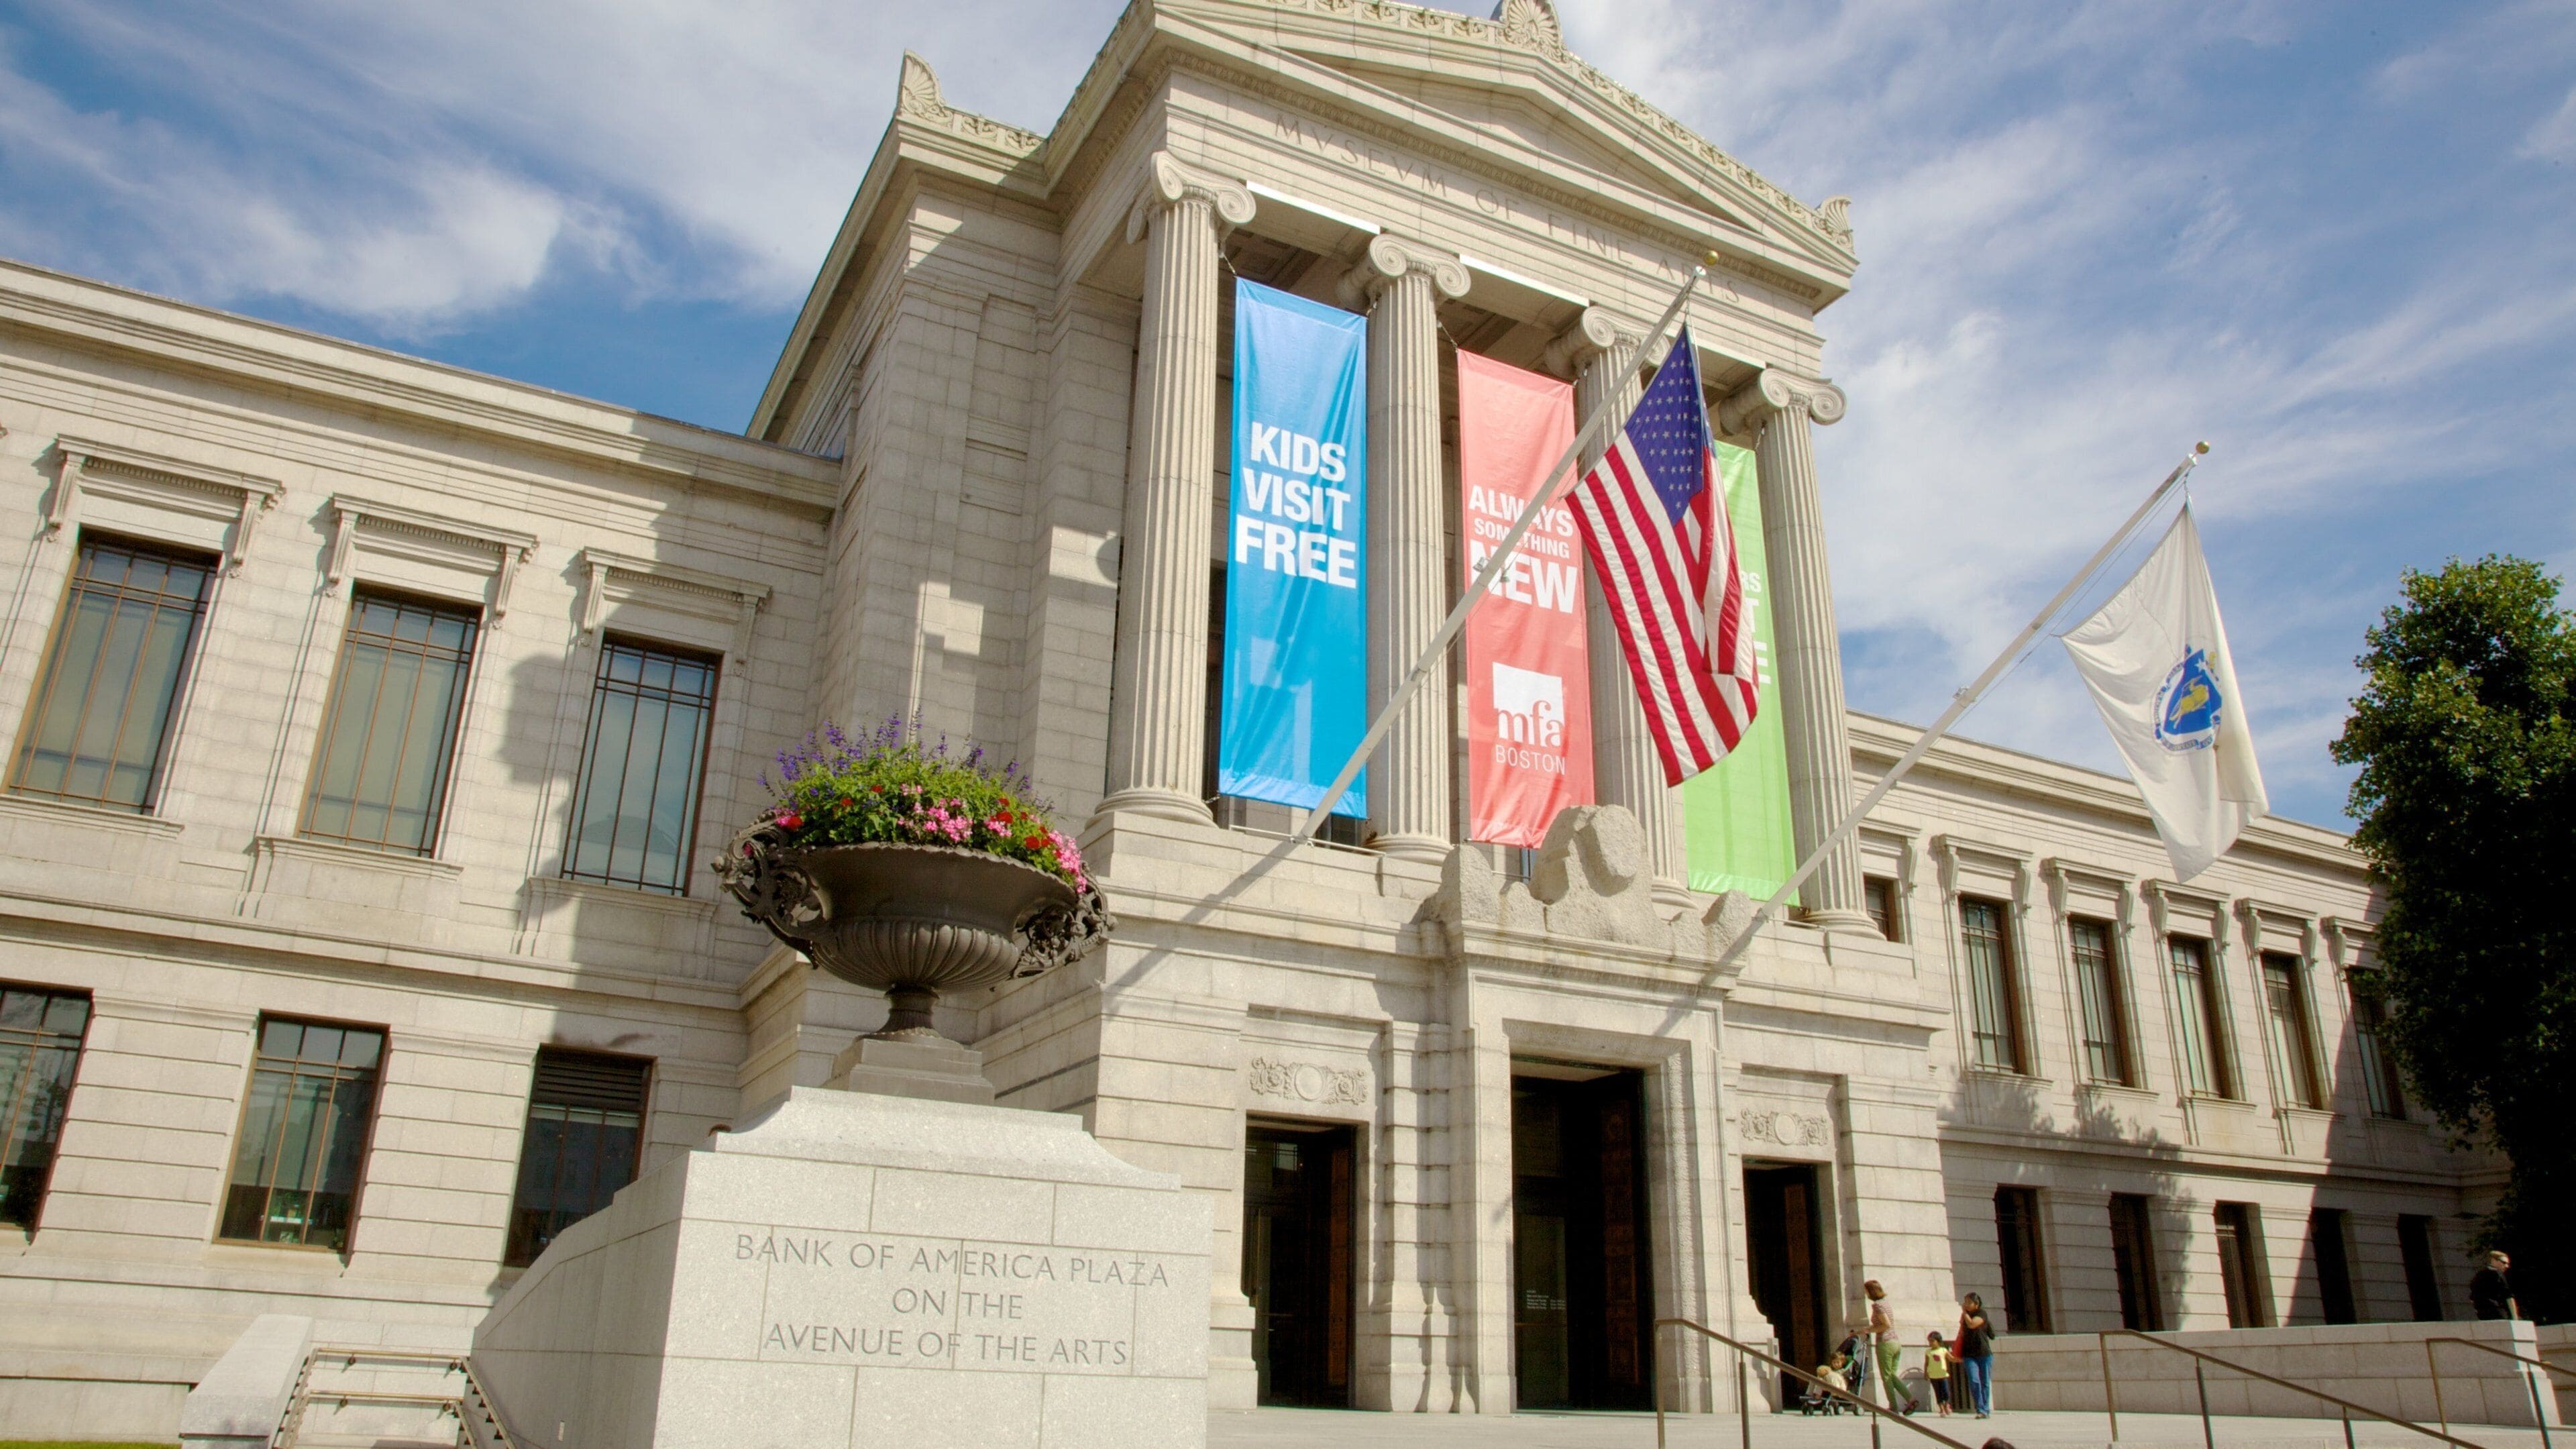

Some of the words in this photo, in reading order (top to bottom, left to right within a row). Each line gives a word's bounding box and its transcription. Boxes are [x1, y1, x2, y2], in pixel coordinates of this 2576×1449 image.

[1275, 113, 1447, 197] MVSEVM
[1475, 189, 1518, 221] OF
[1548, 213, 1633, 265] FINE
[1656, 255, 1740, 304] ARTS
[1250, 421, 1346, 482] KIDS
[1242, 467, 1351, 531] VISIT
[1235, 514, 1356, 589] FREE
[1474, 518, 1570, 559] SOMTHING
[1470, 539, 1578, 614] NEW
[1497, 700, 1564, 747] mfa
[1495, 744, 1566, 776] BOSTON
[735, 1234, 833, 1267] BANK
[850, 1243, 894, 1270] OF
[910, 1247, 1056, 1281] AMERICA
[1070, 1257, 1169, 1288] PLAZA
[893, 1288, 947, 1316] ON
[961, 1292, 1023, 1320] THE
[763, 1323, 904, 1356] AVENUE
[918, 1332, 962, 1358] OF
[975, 1334, 1037, 1362] THE
[1049, 1338, 1127, 1365] ARTS
